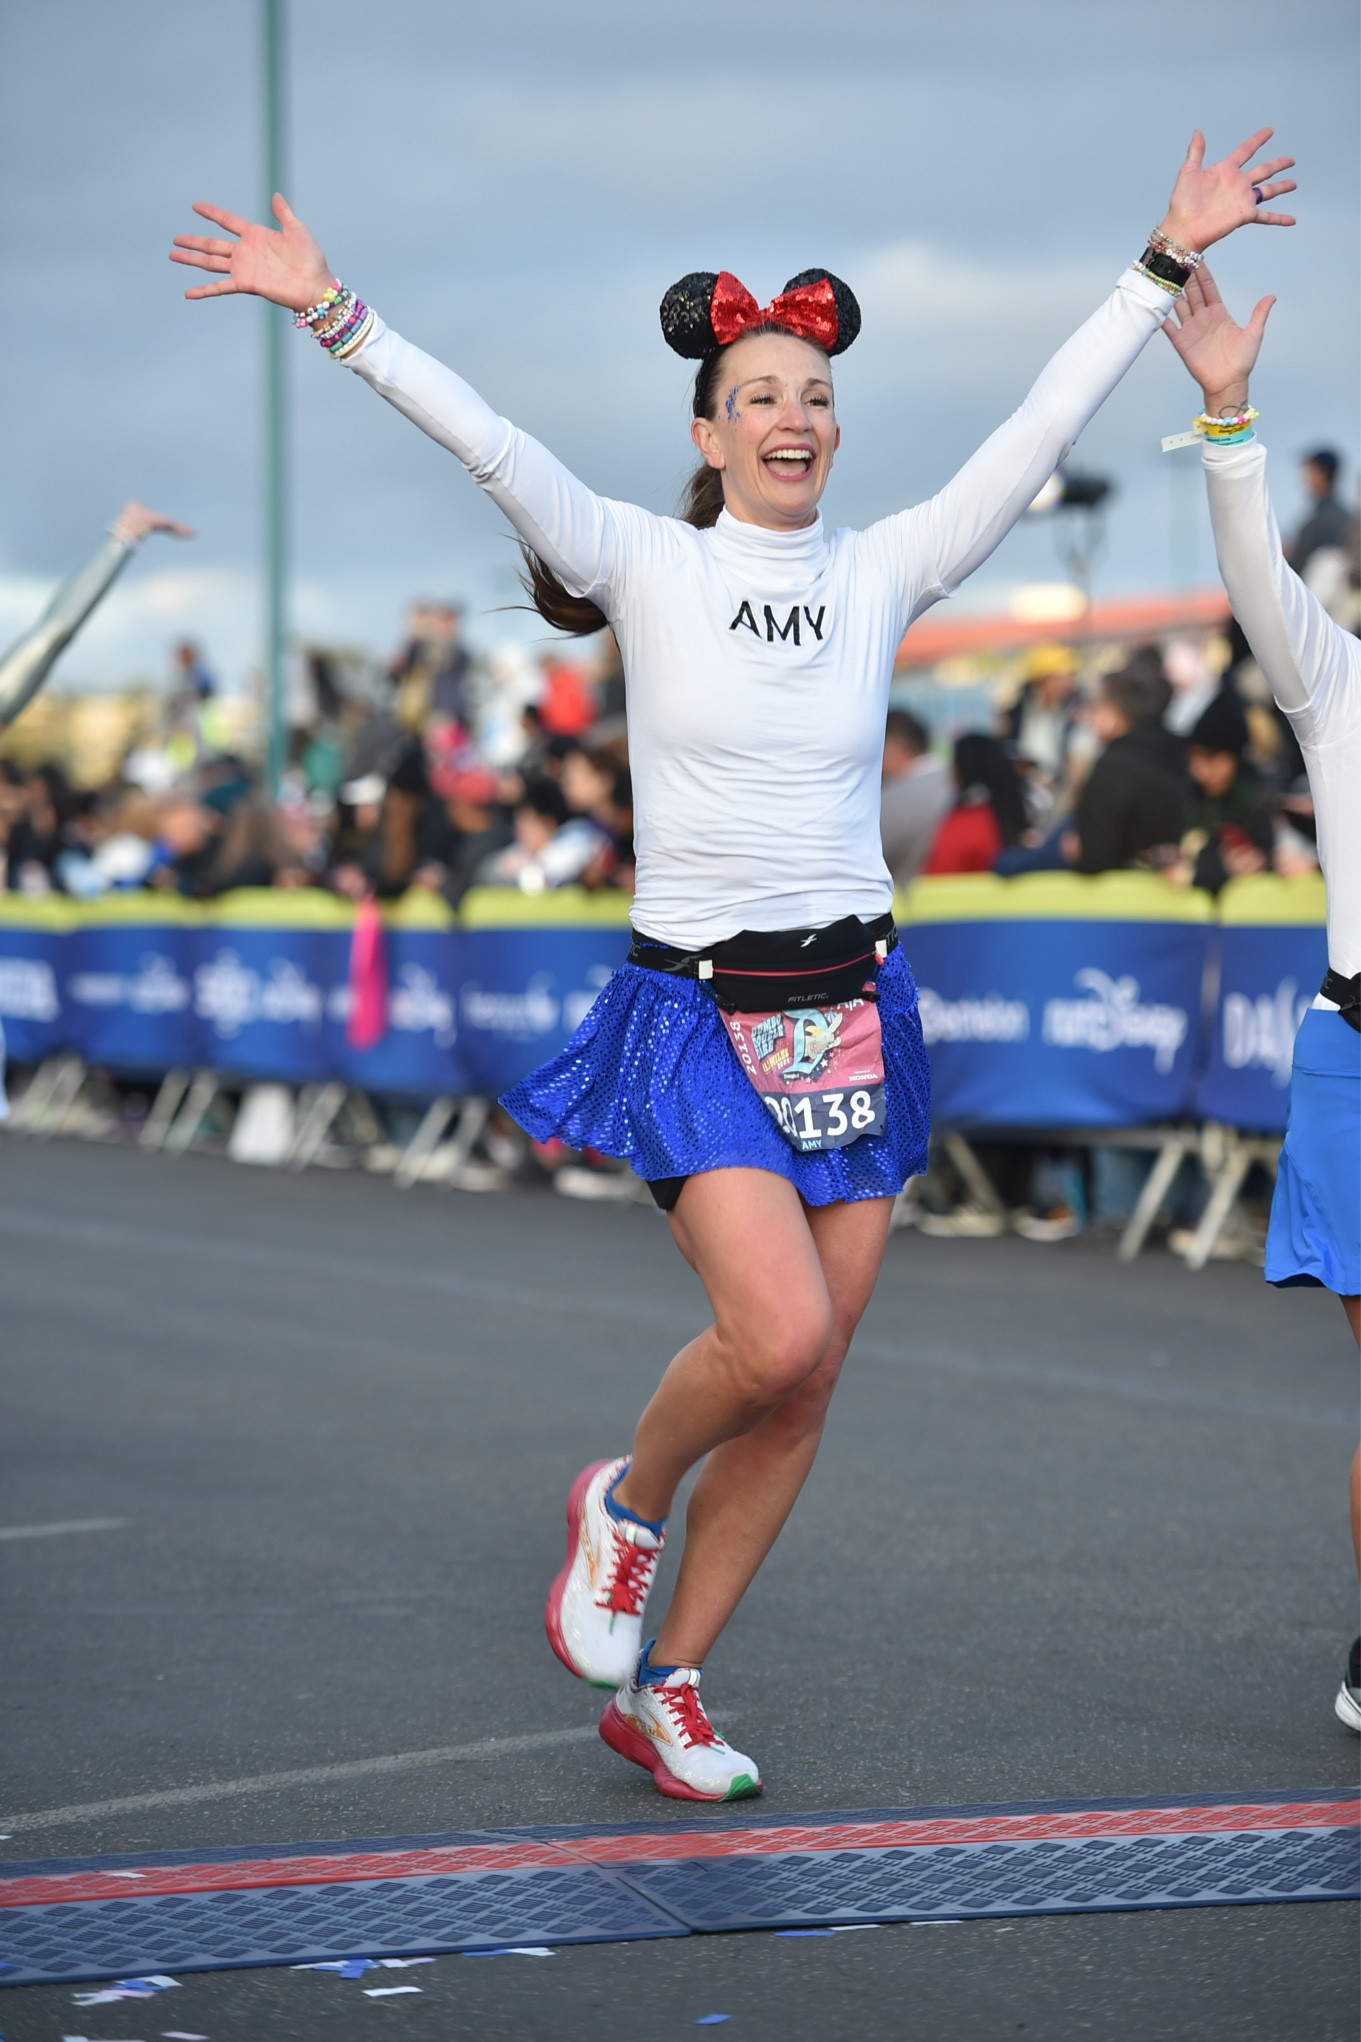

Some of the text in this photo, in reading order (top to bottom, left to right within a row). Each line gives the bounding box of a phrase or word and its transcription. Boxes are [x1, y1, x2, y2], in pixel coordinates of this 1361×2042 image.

[729, 600, 826, 646] AMY
[787, 992, 827, 1003] FITLETIC
[751, 1014, 782, 1037] DUMBO
[730, 1021, 757, 1075] 20138
[848, 1073, 878, 1082] HONDA
[802, 1140, 822, 1150] AMY
